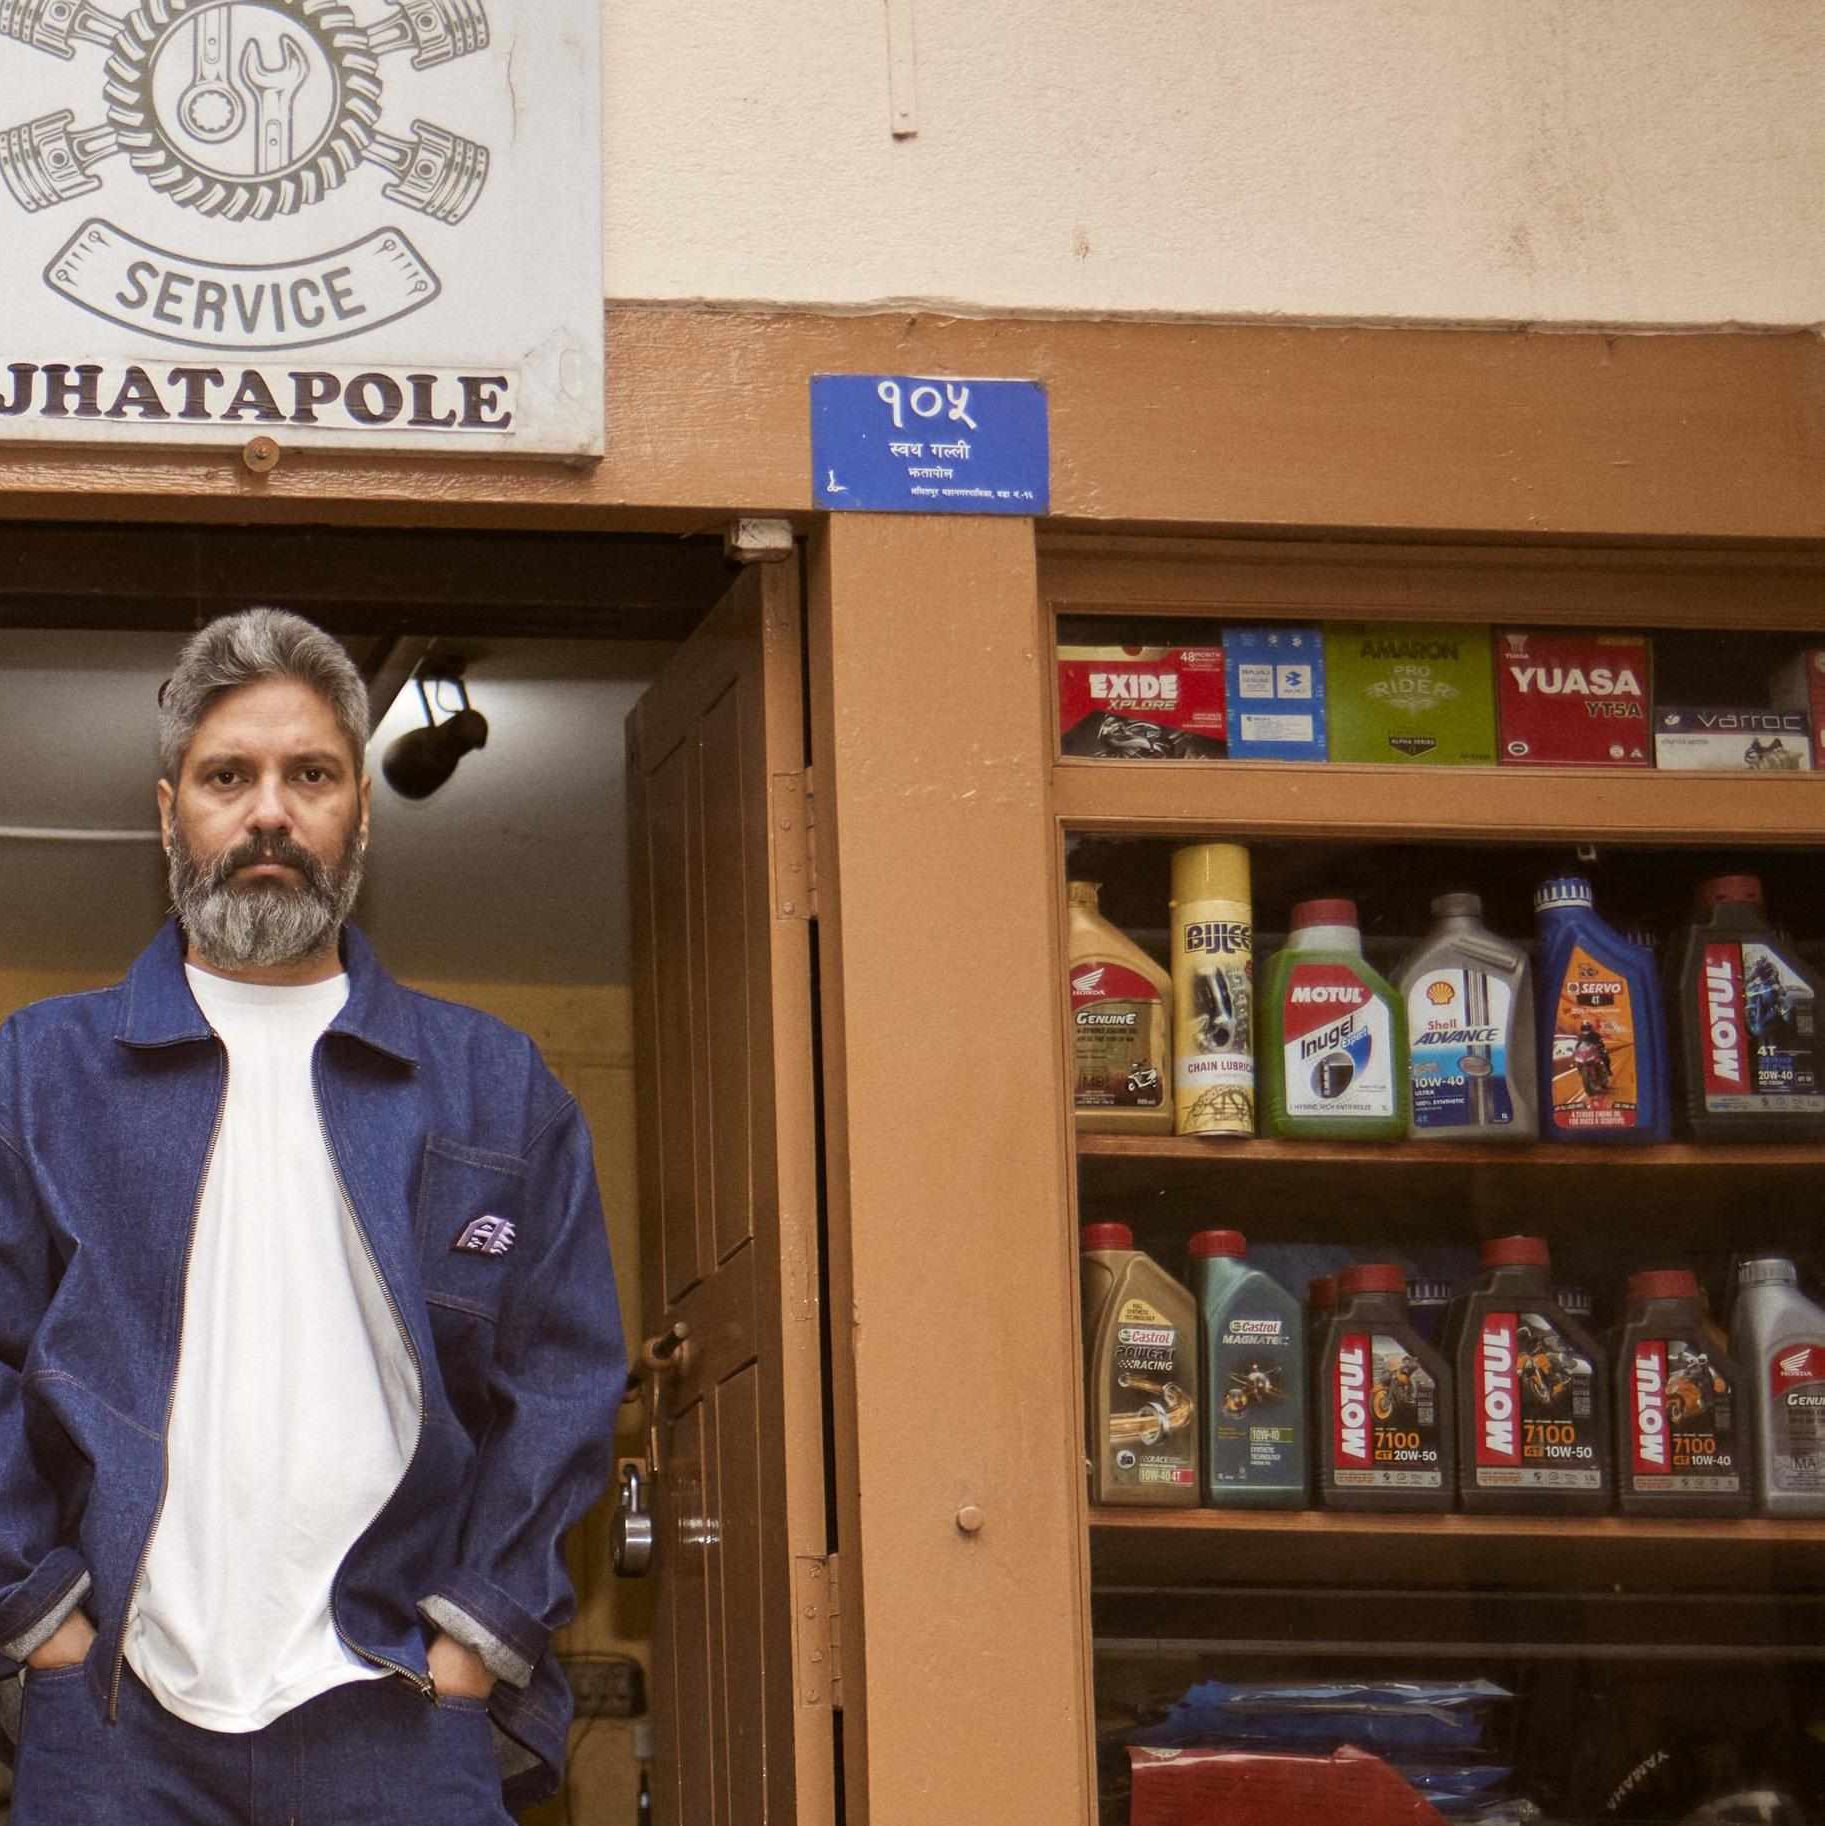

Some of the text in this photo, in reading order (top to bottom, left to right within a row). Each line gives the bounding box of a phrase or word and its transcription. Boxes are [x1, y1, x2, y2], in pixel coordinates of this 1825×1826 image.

[117, 259, 367, 336] SERVICE
[877, 380, 978, 430] १०५
[1394, 666, 1431, 677] PRO
[1089, 673, 1179, 699] EXIDE
[1373, 679, 1452, 697] RIDER
[1510, 667, 1642, 696] YUASA
[1107, 700, 1178, 710] XPLORE
[1586, 701, 1643, 719] YT5A
[1291, 986, 1363, 1004] MOTUL
[1581, 983, 1622, 994] SERVO
[1428, 1018, 1457, 1031] Shell
[1706, 960, 1741, 1081] MOTUL
[1414, 1028, 1500, 1046] ADVANCE
[1188, 1061, 1217, 1073] CHAIN
[1414, 1075, 1465, 1089] 10W-40
[1242, 1321, 1278, 1333] Castrol
[1132, 1330, 1171, 1344] Castrol
[1133, 1360, 1174, 1371] RACING
[1483, 1327, 1514, 1457] MOTUL
[1339, 1348, 1366, 1459] MOTUL
[1636, 1353, 1665, 1465] MOTUL
[1374, 1432, 1420, 1449] 7100
[1523, 1424, 1575, 1445] 7100
[1546, 1446, 1592, 1459] 10W-50
[1673, 1438, 1717, 1454] 7100
[1394, 1450, 1437, 1461] 20W-50
[1691, 1455, 1732, 1467] 10W-40
